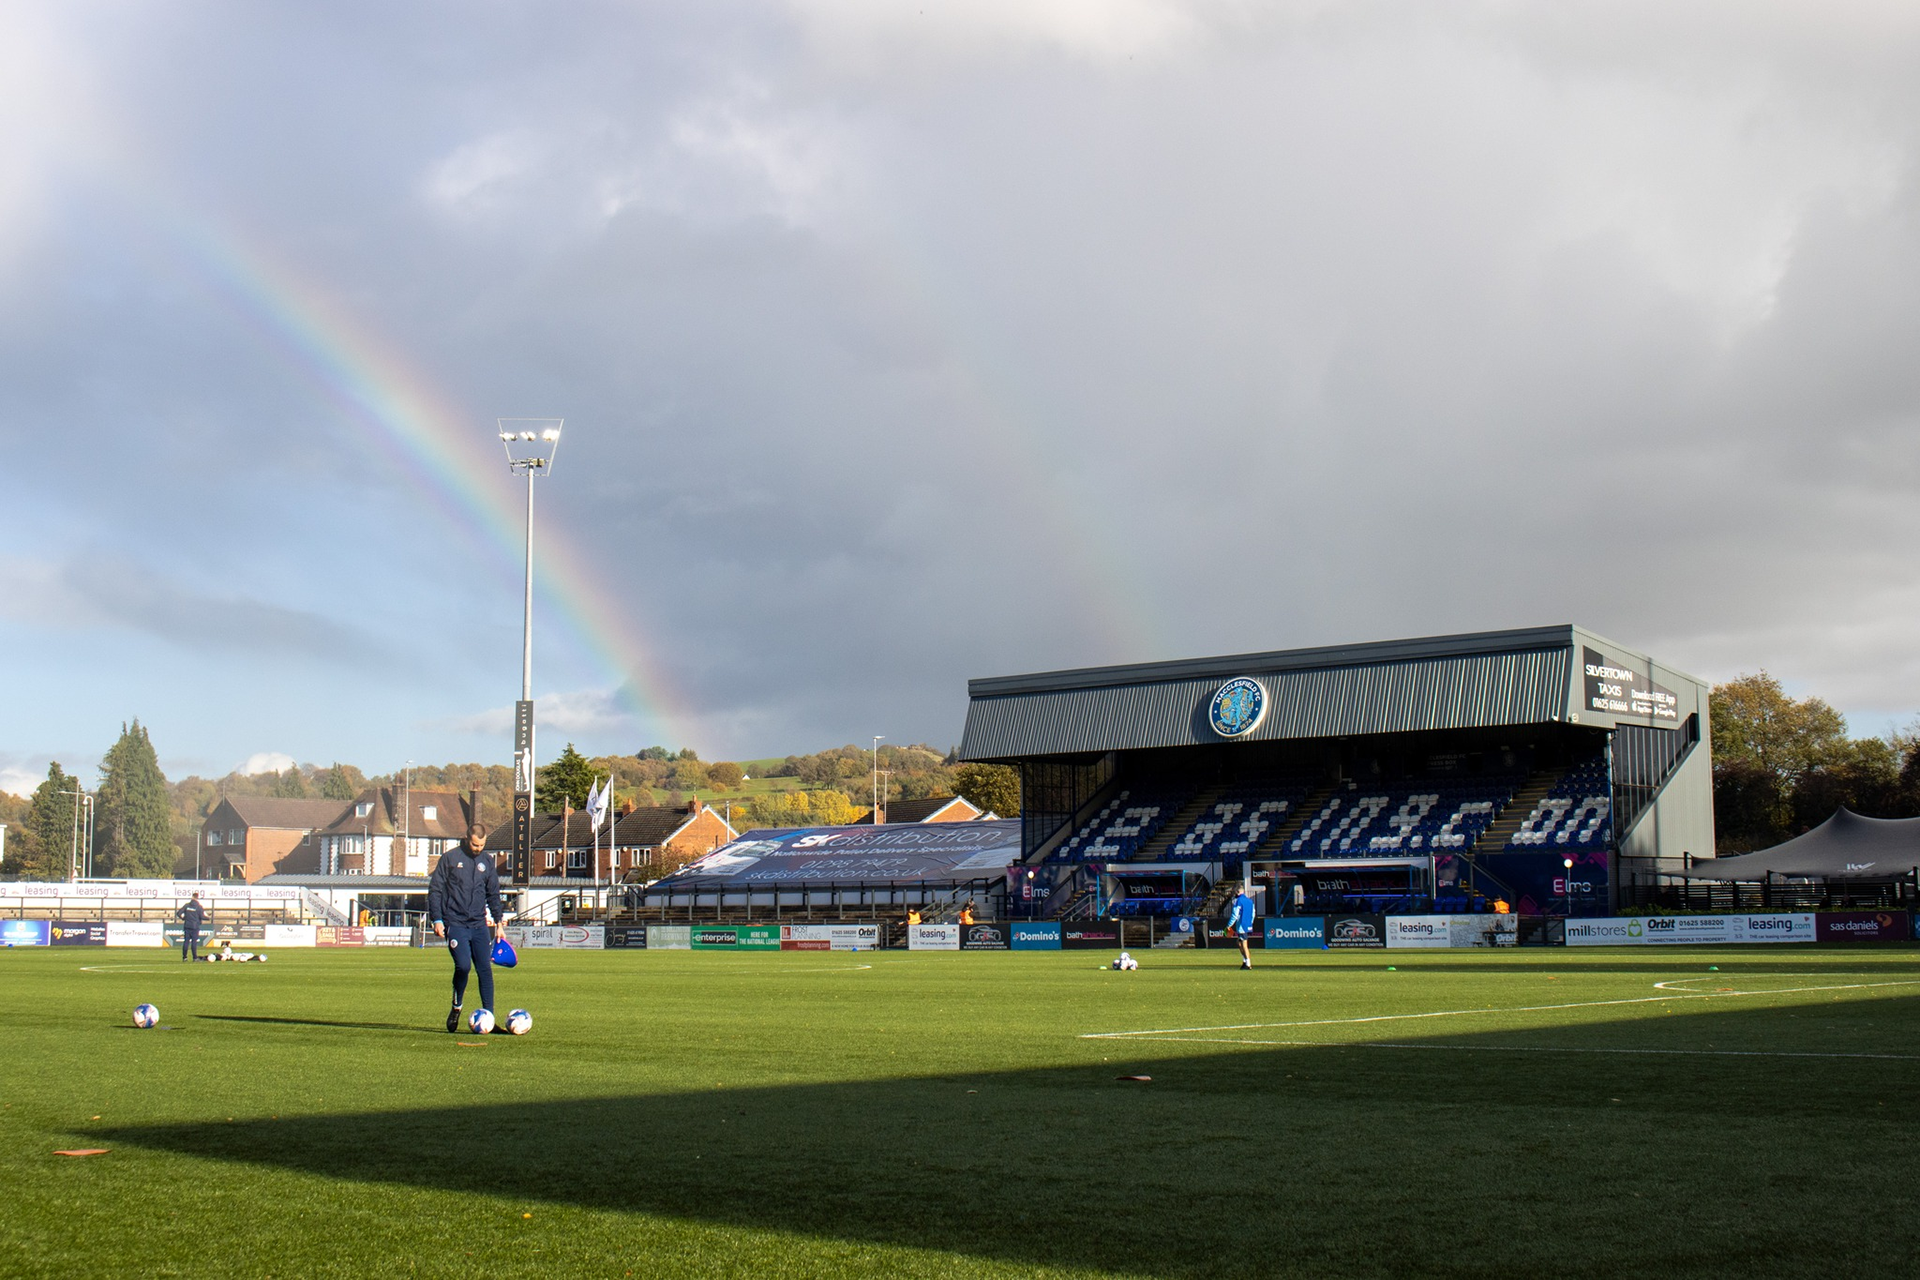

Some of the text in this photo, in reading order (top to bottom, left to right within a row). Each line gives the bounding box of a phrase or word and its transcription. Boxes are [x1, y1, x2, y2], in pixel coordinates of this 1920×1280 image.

[1586, 664, 1633, 681] SILVERTOWN
[1216, 680, 1261, 703] MACCLESFIELD FC
[1598, 683, 1622, 696] TAXIS
[1592, 697, 1608, 709] 01625
[1631, 689, 1654, 702] Download
[1655, 692, 1666, 703] FREE
[1666, 694, 1676, 706] App
[1216, 720, 1231, 733] SINCE
[868, 847, 917, 855] Delivery
[918, 845, 984, 853] Specialists
[800, 859, 853, 869] 01298
[745, 867, 926, 880] skdistribution.co.uk
[25, 886, 58, 897] leasing
[76, 886, 108, 898] leasing
[126, 886, 158, 898] leasing
[221, 887, 251, 898] leasing
[267, 888, 296, 899] leasing
[1022, 886, 1050, 897] Elms
[307, 894, 325, 914] leasing
[326, 908, 345, 926] leasing
[1399, 922, 1447, 935] leasing.com
[1647, 919, 1675, 928] Orbit
[1748, 917, 1811, 932] leasing.com
[1846, 920, 1879, 930] daniels
[109, 929, 162, 937] TransferTravel.com
[532, 928, 553, 940] spiral
[858, 928, 876, 936] Orbit
[919, 928, 957, 939] leasing.com
[1020, 931, 1059, 941] Domino's
[1275, 927, 1322, 938] Domino's
[1568, 925, 1626, 936] millstores
[694, 933, 736, 942] enterprise
